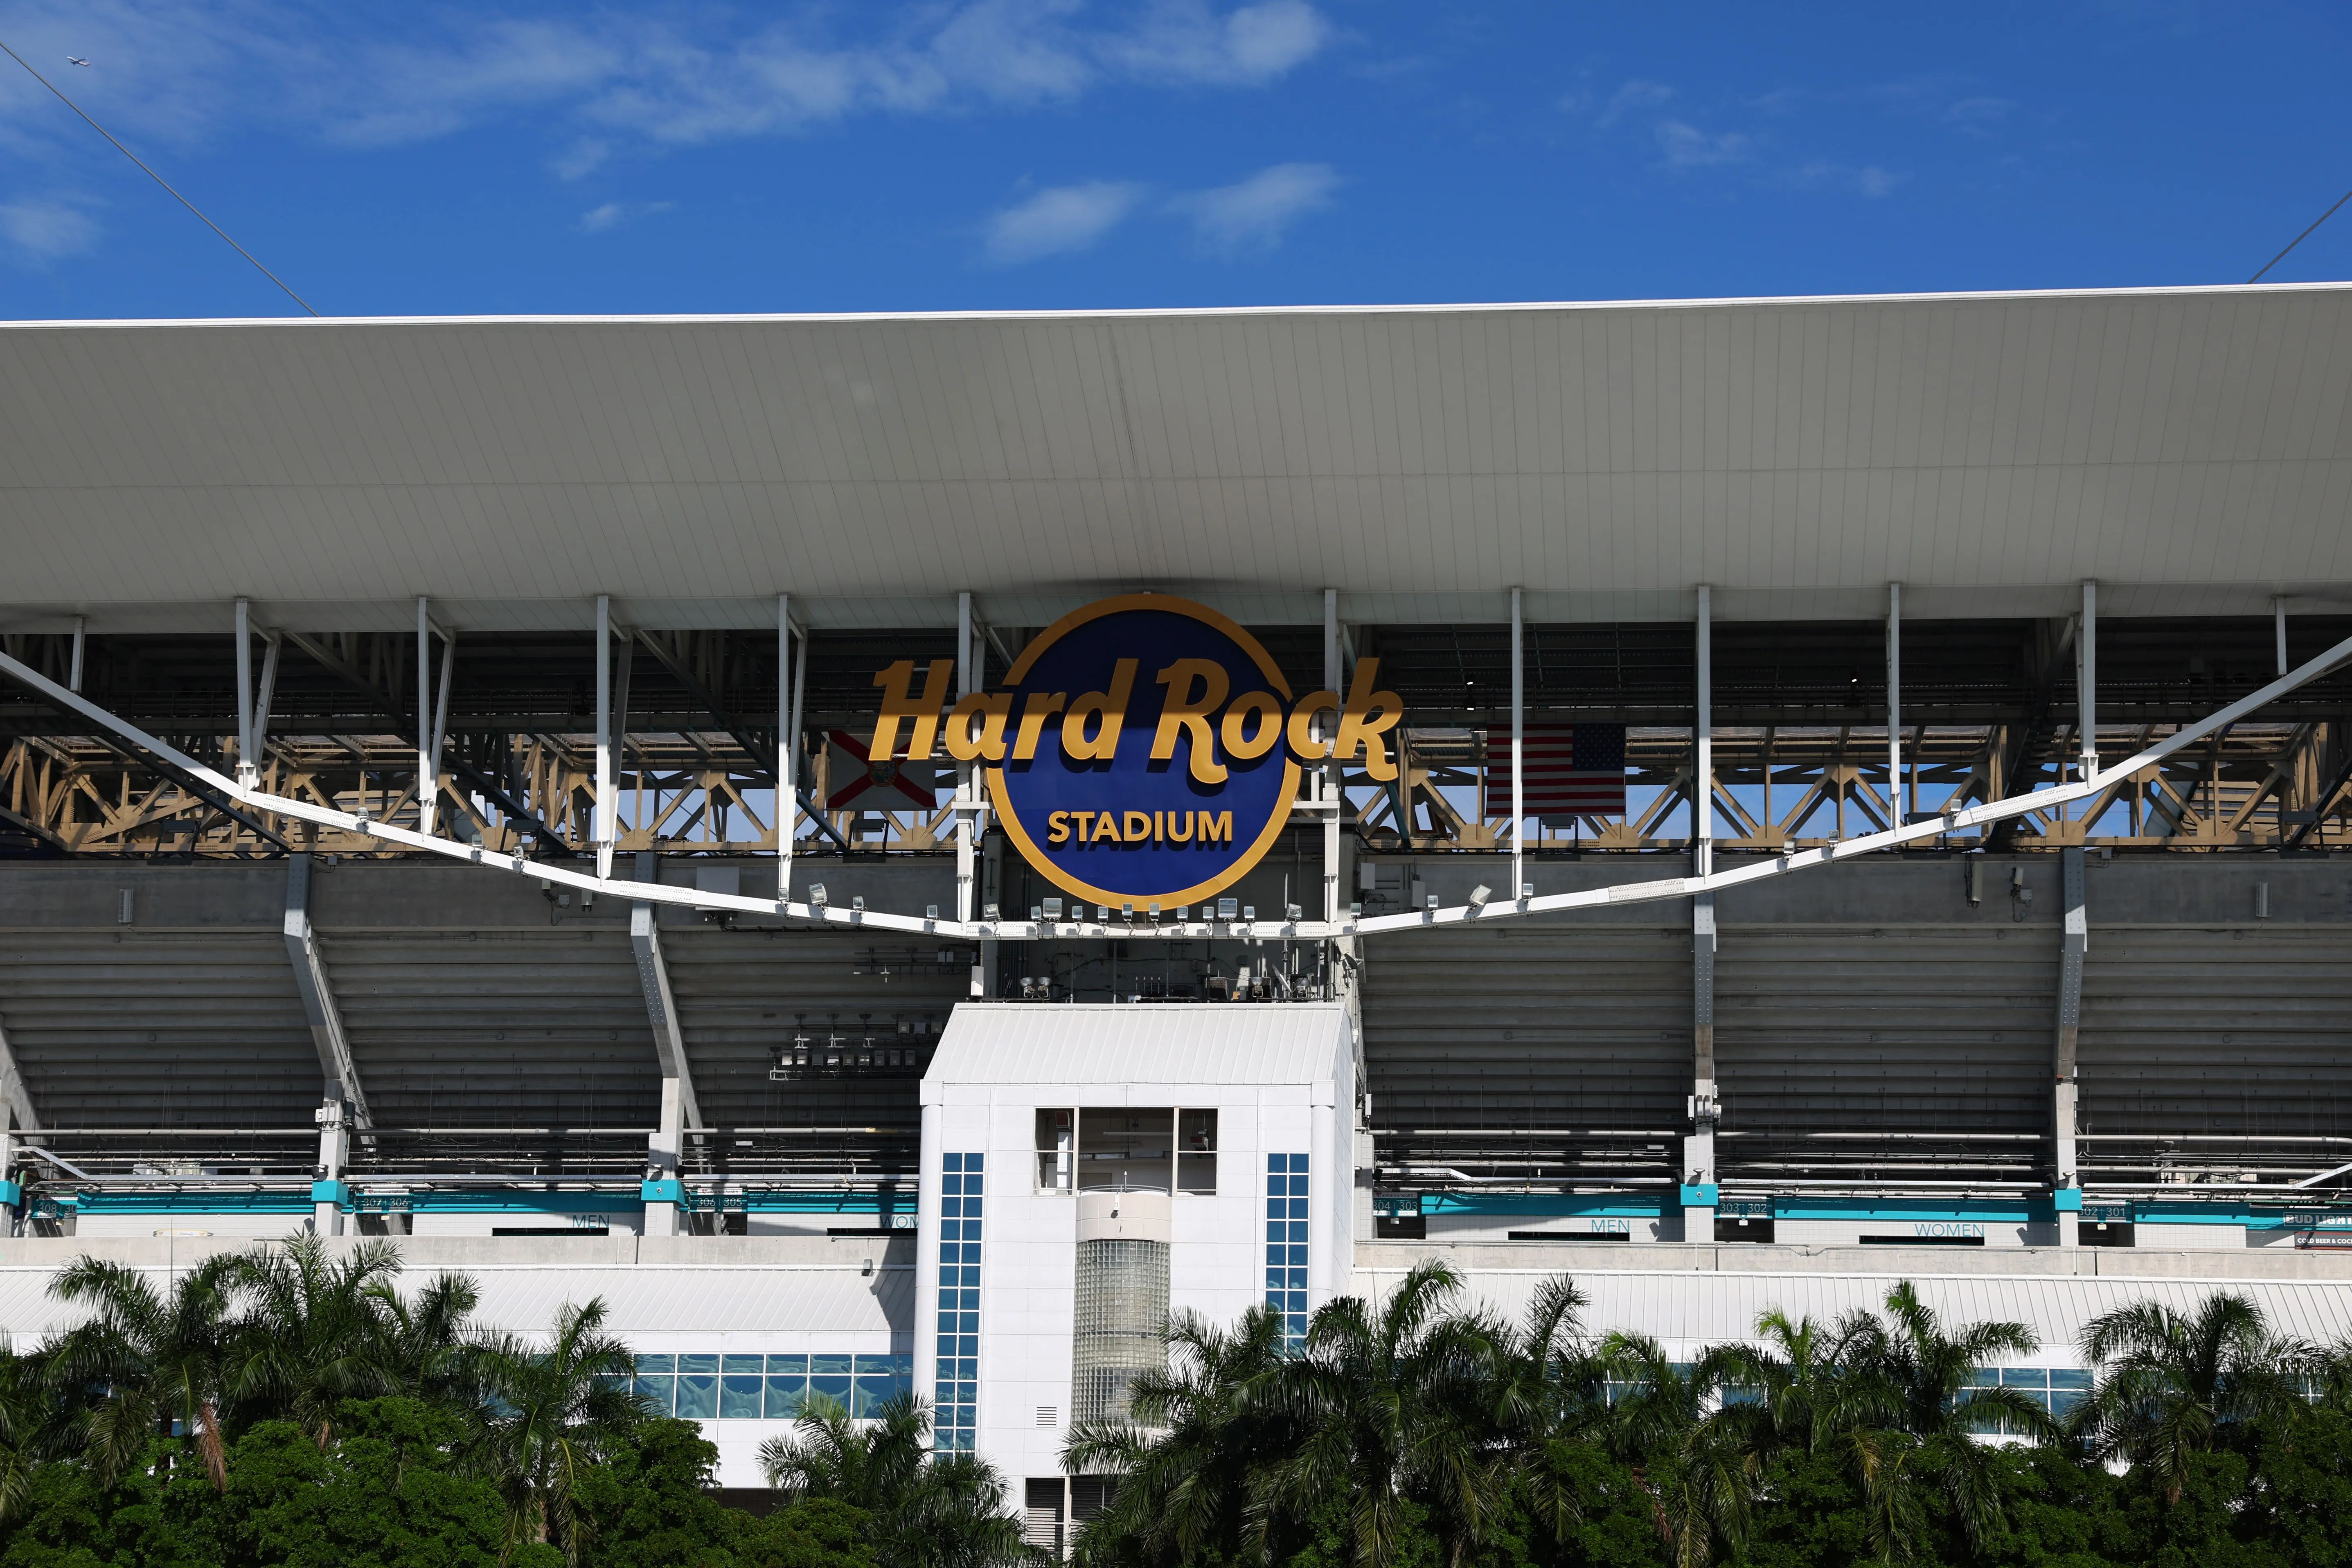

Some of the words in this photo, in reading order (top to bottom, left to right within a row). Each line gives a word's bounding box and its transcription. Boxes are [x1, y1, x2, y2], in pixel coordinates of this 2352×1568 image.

[868, 658, 1139, 761] Hard
[1150, 657, 1404, 784] Rock
[1048, 811, 1232, 842] STADIUM
[364, 1198, 382, 1207] 307
[390, 1198, 408, 1207] 306
[697, 1198, 715, 1206] 306
[723, 1198, 742, 1206] 305
[1373, 1201, 1390, 1210] 304
[1399, 1201, 1417, 1210] 303
[39, 1204, 56, 1212] 308
[1720, 1203, 1739, 1212] 303
[1748, 1203, 1767, 1212] 302
[2106, 1208, 2125, 1216] 301
[573, 1215, 609, 1228] MEN
[2285, 1214, 2313, 1223] BUD
[2316, 1215, 2352, 1224] LIGHT
[1592, 1219, 1629, 1232] MEN
[1915, 1224, 1984, 1237] WOMEN
